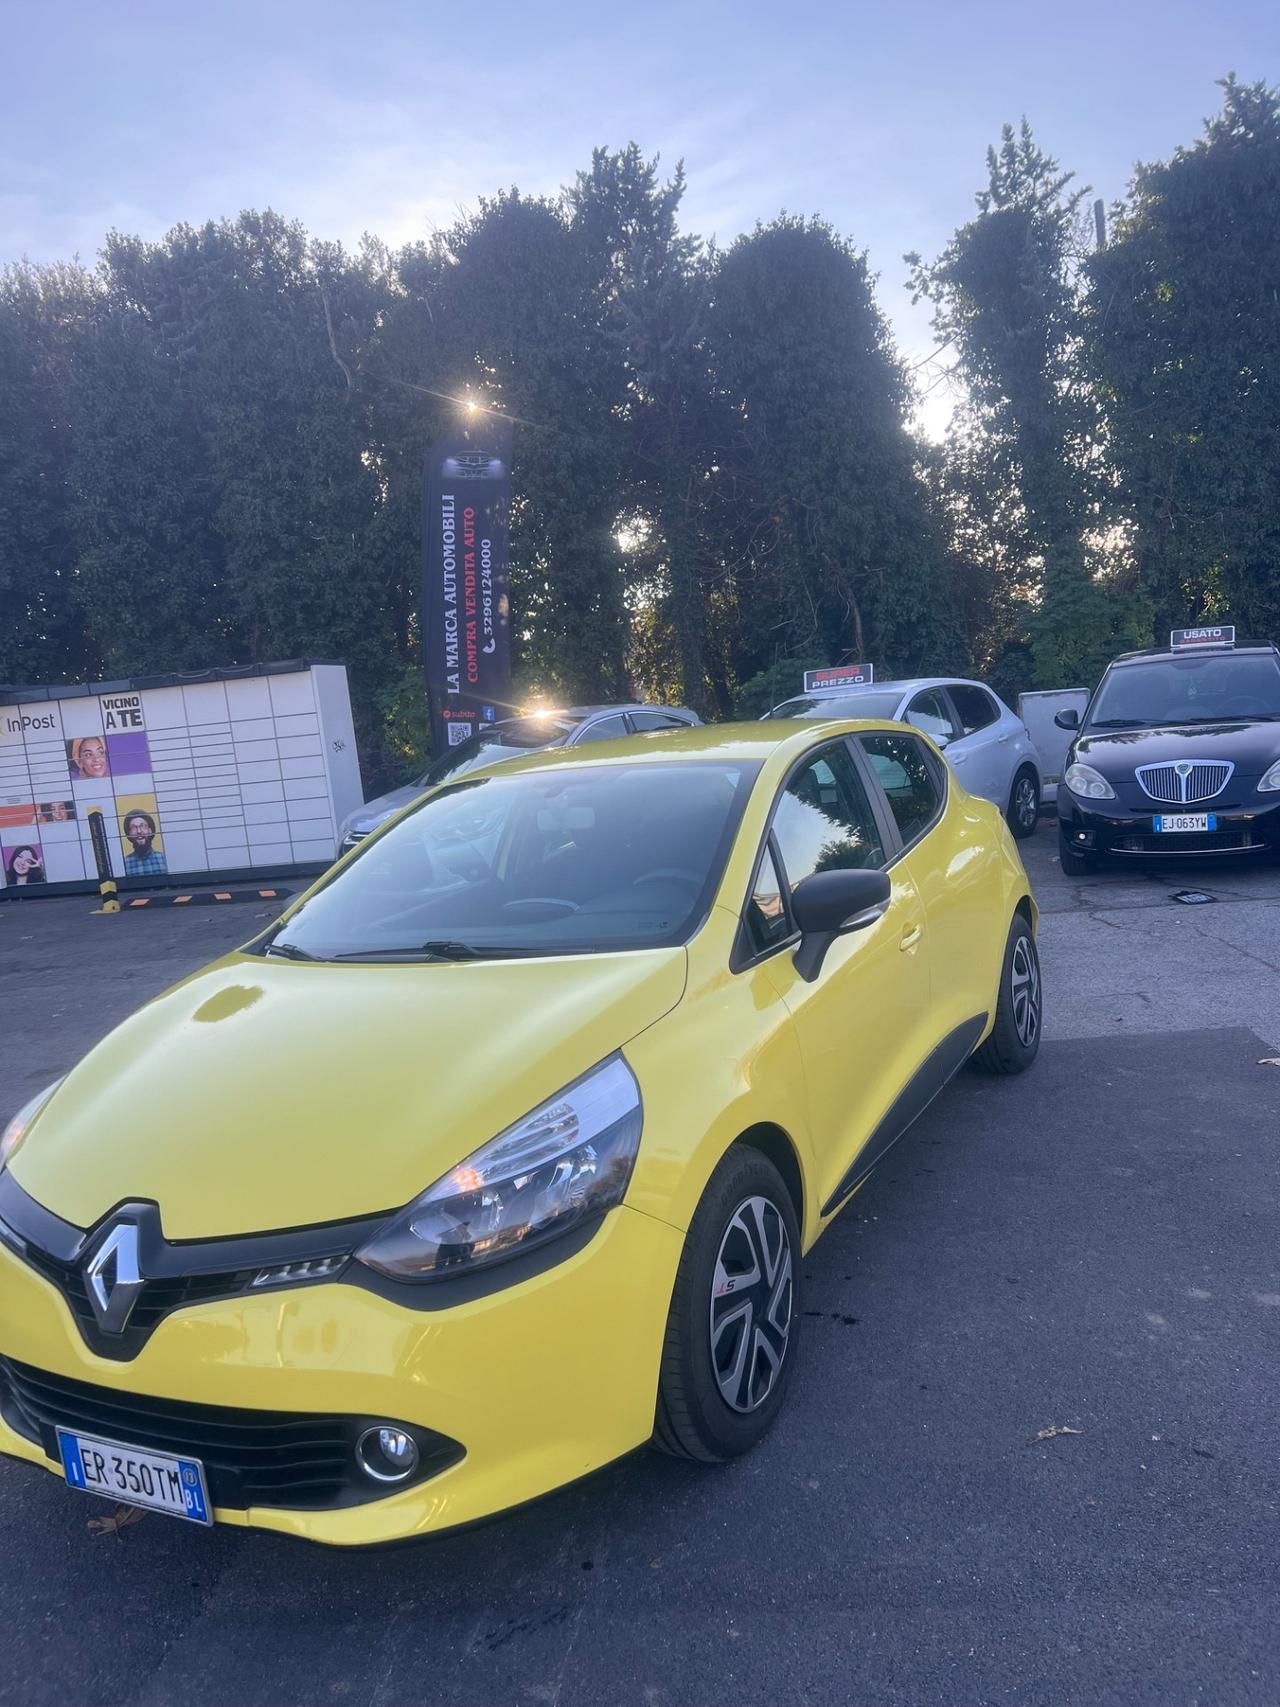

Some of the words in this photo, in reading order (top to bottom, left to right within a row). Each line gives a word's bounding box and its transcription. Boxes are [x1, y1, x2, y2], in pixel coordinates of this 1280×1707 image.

[463, 507, 475, 547] AUTO
[442, 494, 457, 604] AUTOMOBILI
[464, 552, 476, 616] VENDITA
[481, 539, 492, 635] 3296124000
[445, 608, 459, 668] MARCA
[1183, 629, 1222, 639] USATO
[466, 620, 478, 683] COMPRA
[447, 673, 460, 694] LA
[812, 676, 864, 688] PREZZO
[103, 697, 139, 709] VICINO
[7, 714, 55, 732] InPost
[106, 711, 117, 729] A
[117, 708, 143, 728] TE
[184, 1488, 203, 1512] BL
